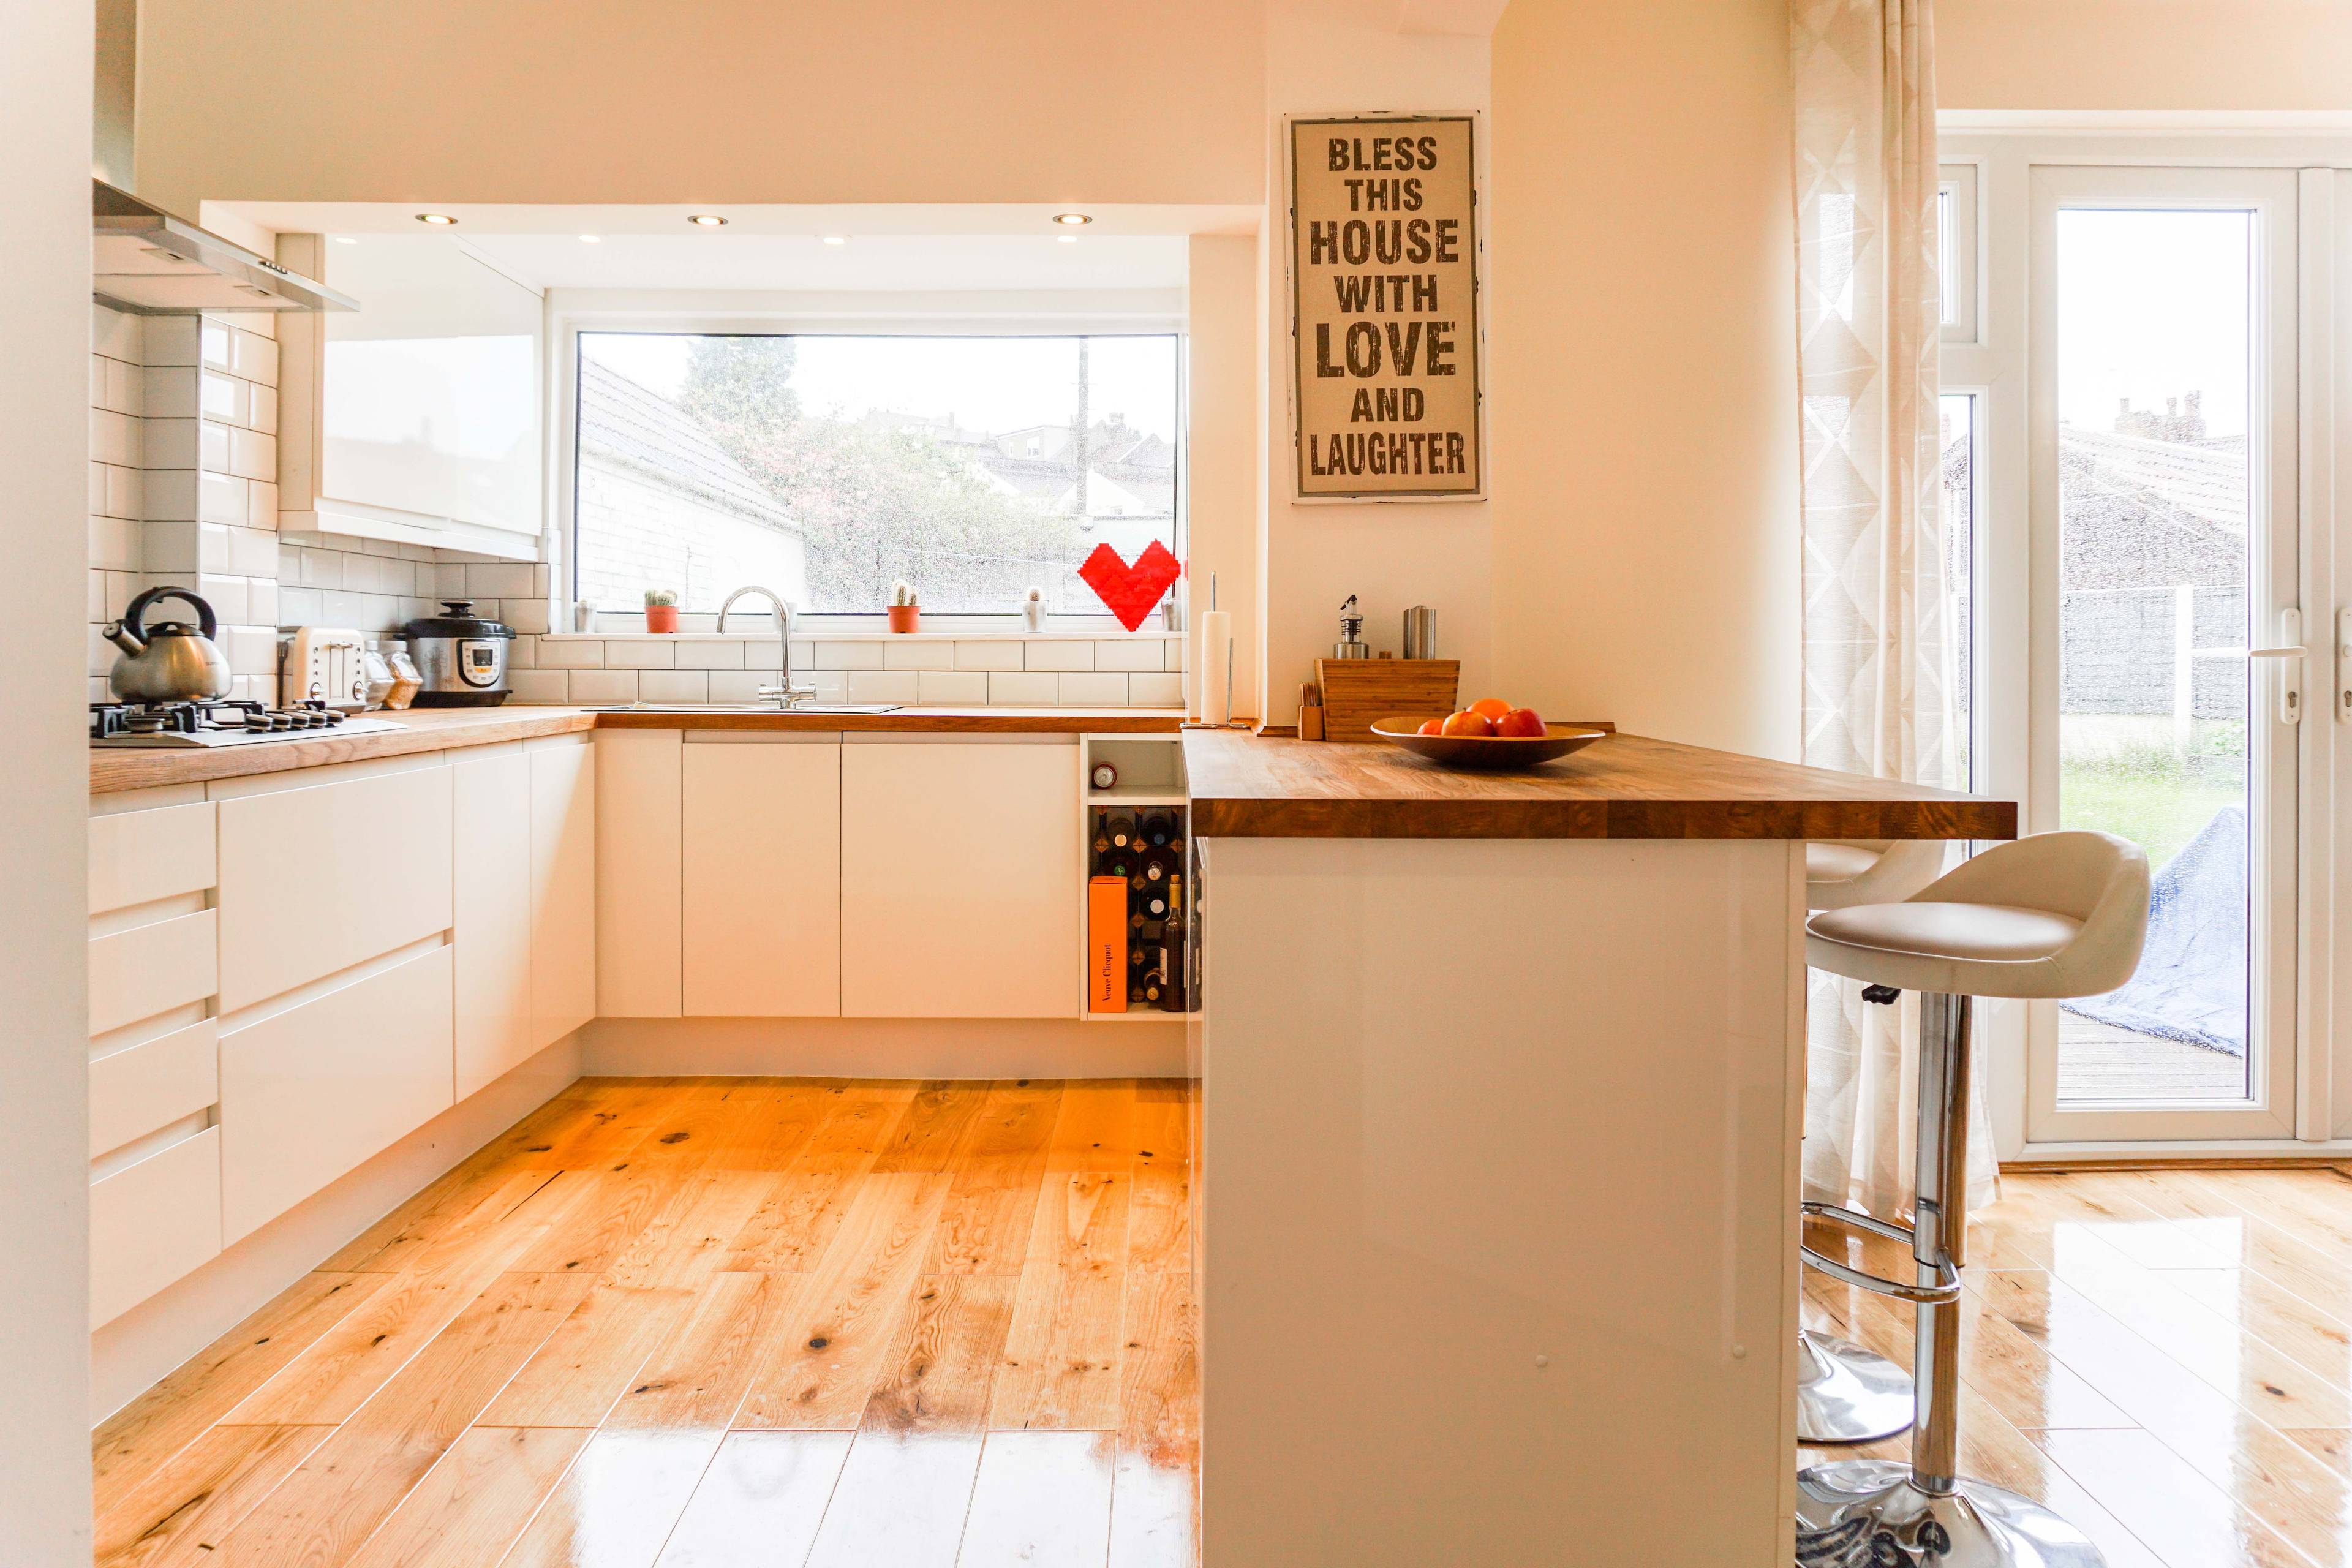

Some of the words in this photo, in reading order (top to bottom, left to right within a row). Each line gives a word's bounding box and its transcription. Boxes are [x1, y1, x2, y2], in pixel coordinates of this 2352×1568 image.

[1328, 136, 1438, 172] BLESS
[1344, 178, 1423, 211] THIS
[1310, 219, 1458, 265] HOUSE
[1333, 274, 1438, 313] WITH
[1316, 321, 1456, 379] LOVE
[1350, 387, 1425, 423] AND
[1310, 432, 1466, 476] LAUGHTER
[1102, 944, 1113, 977] Clicquot
[1102, 979, 1112, 1002] Veuve
